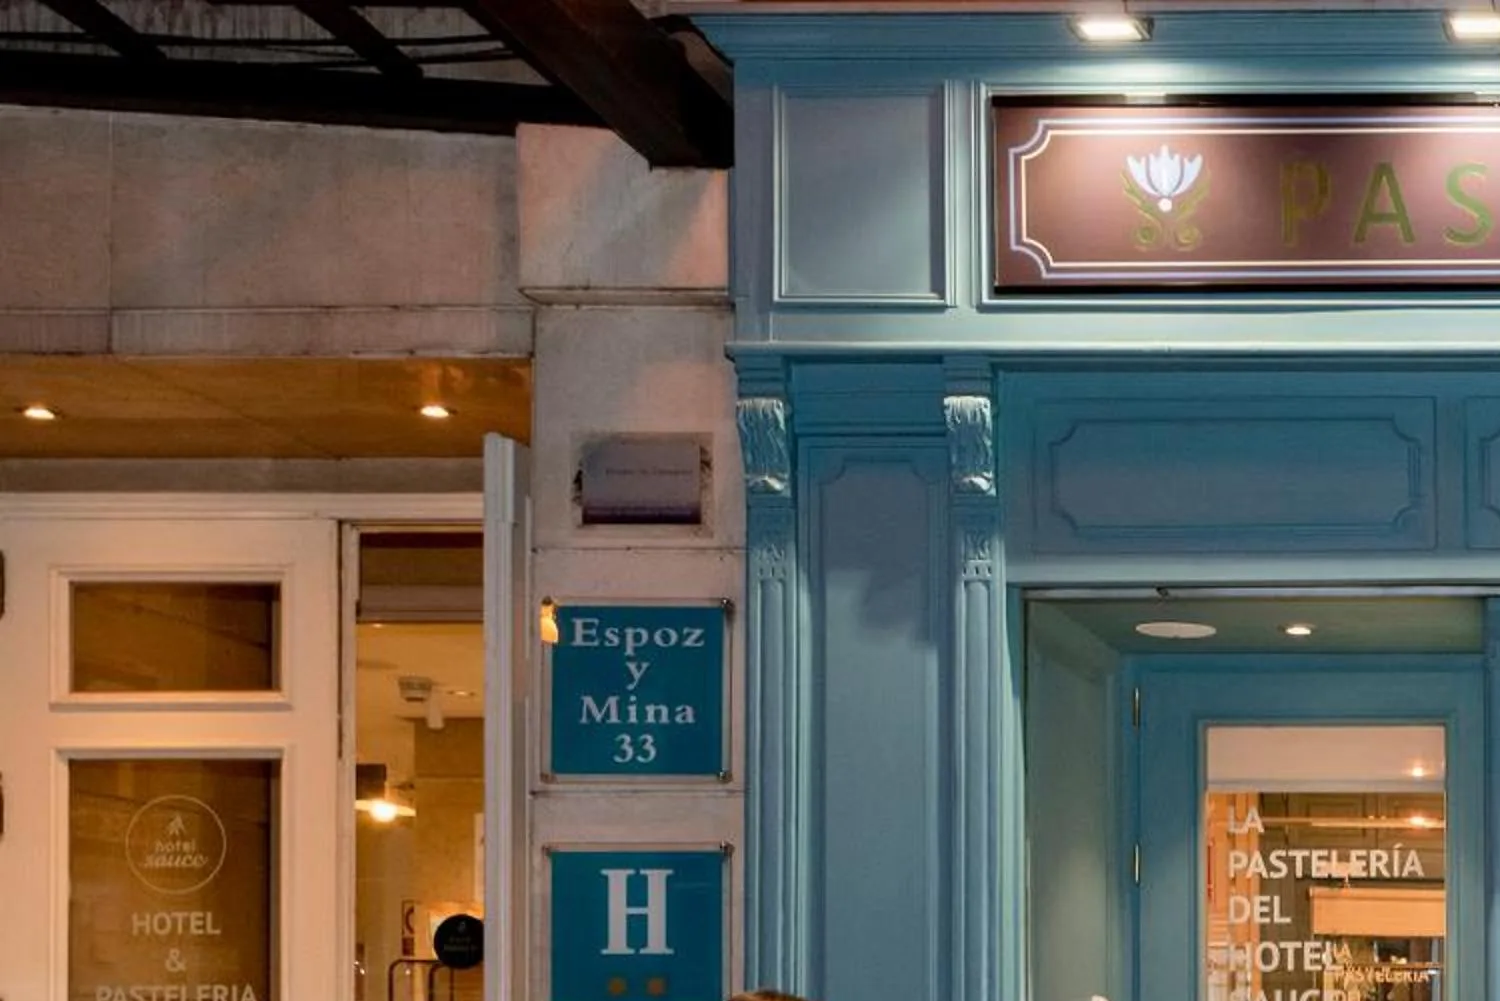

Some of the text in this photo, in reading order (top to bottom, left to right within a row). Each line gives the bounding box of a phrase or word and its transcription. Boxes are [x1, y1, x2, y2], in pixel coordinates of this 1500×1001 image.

[571, 617, 705, 656] Espoz
[625, 660, 650, 690] y
[579, 695, 696, 724] Mina
[613, 733, 657, 763] 33
[1228, 805, 1265, 834] LA
[1228, 842, 1425, 879] PASTELERÍA
[131, 911, 222, 936] HOTEL
[600, 868, 675, 955] H
[1228, 895, 1292, 924] DEL
[164, 948, 188, 972] &
[1229, 940, 1342, 972] HOTEL
